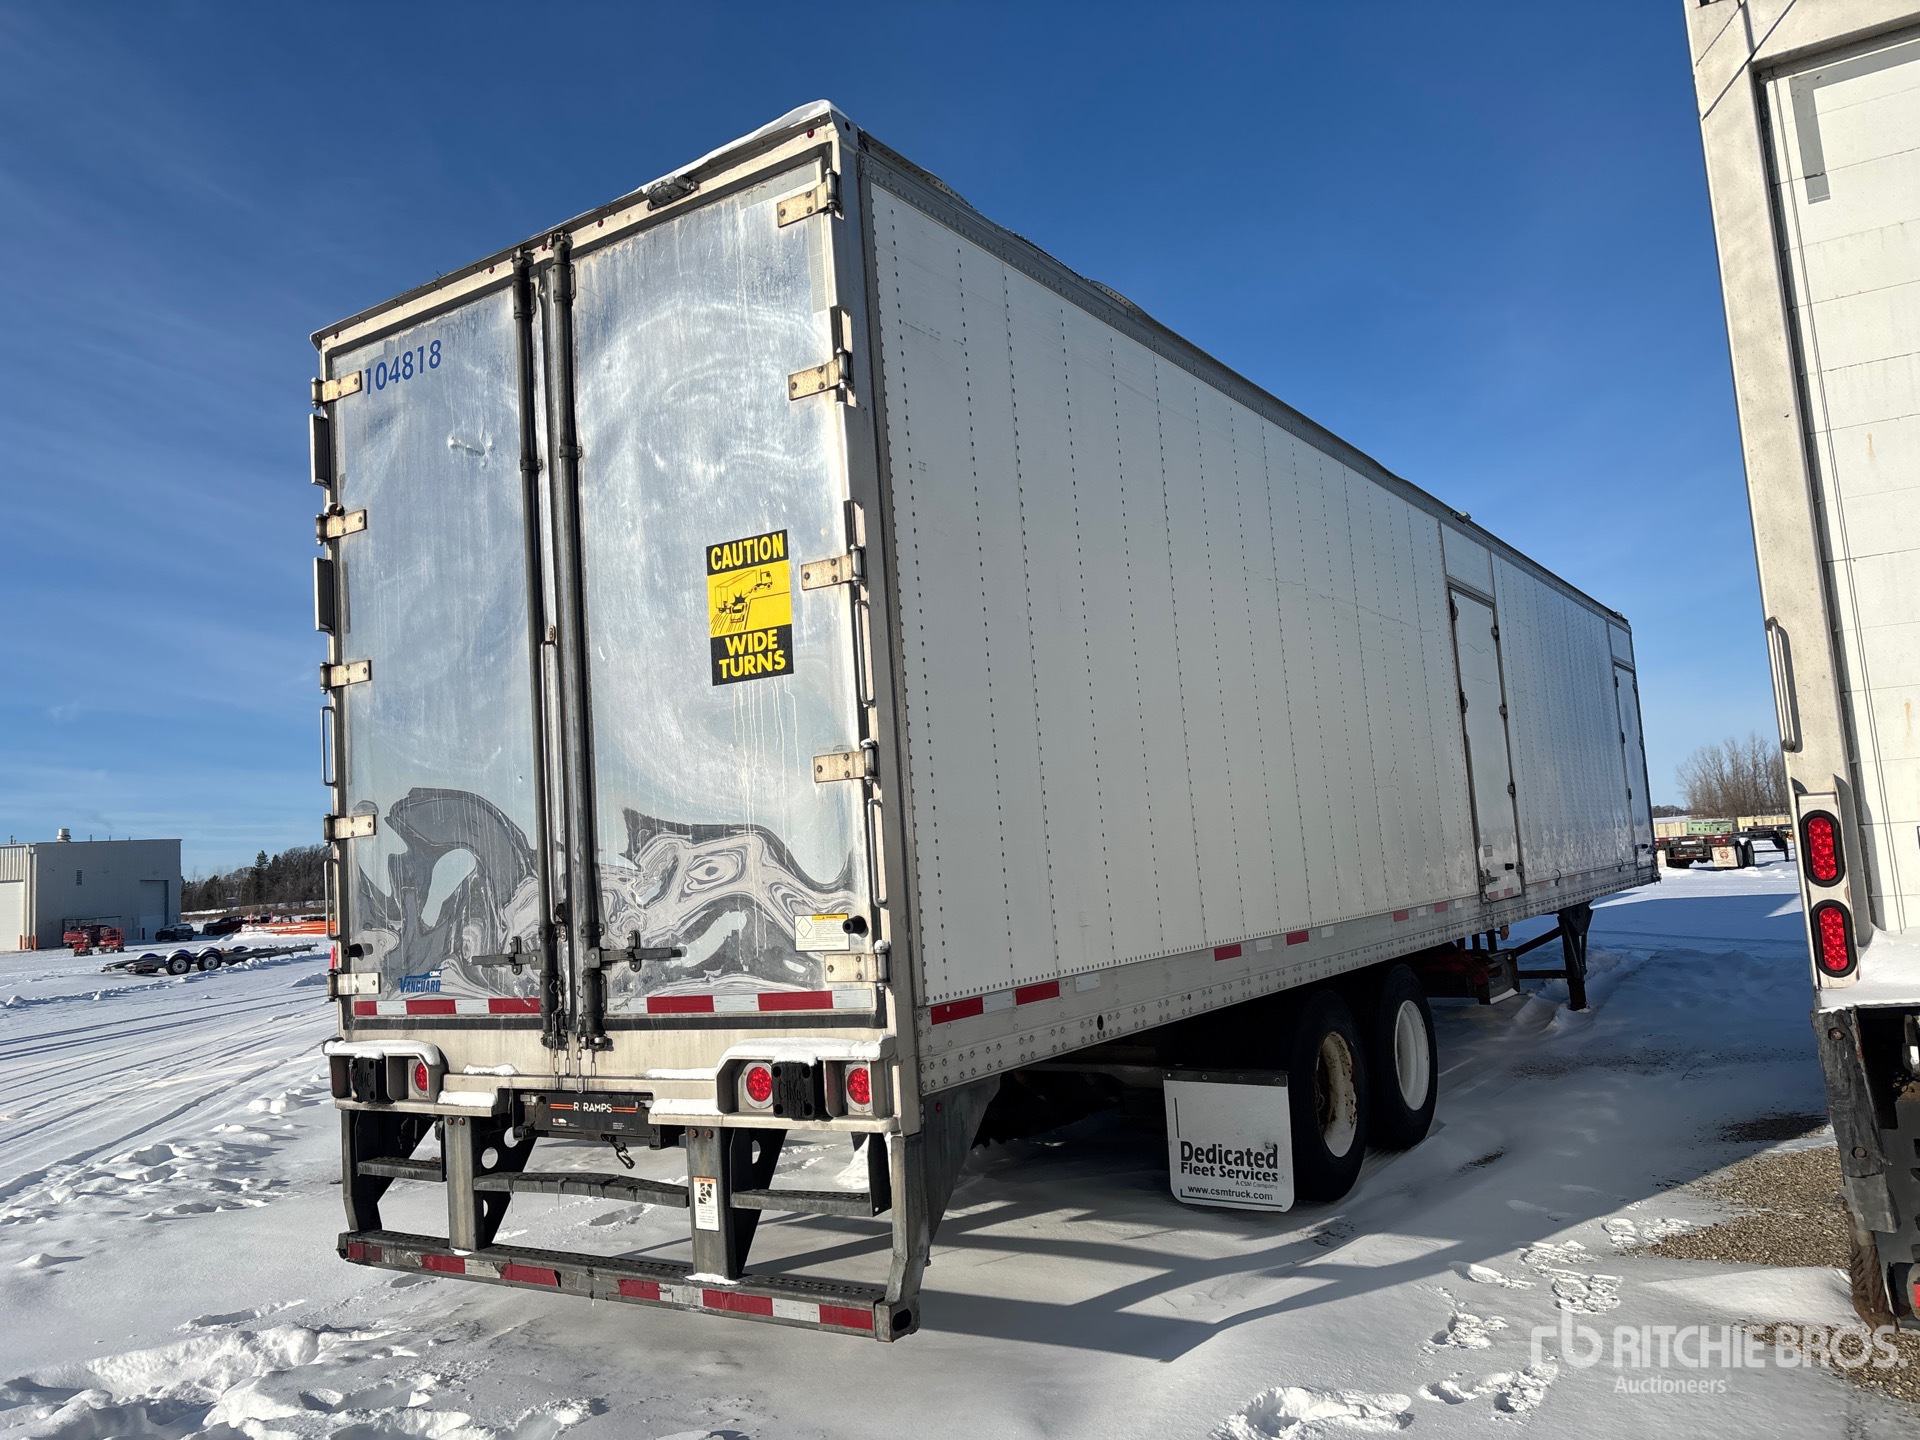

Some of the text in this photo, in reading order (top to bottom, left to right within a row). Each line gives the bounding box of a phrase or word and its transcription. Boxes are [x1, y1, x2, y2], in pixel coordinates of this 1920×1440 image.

[365, 340, 441, 394] 104818
[711, 533, 784, 570] CAUTION
[725, 629, 778, 656] WIDE
[719, 650, 786, 679] TURNS
[398, 977, 441, 993] VANGUARD
[583, 1102, 613, 1113] RAMPS
[1180, 1141, 1278, 1169] Dedicated
[1181, 1162, 1279, 1182] Fleet Services
[1187, 1185, 1273, 1201] www.csmtruck.com
